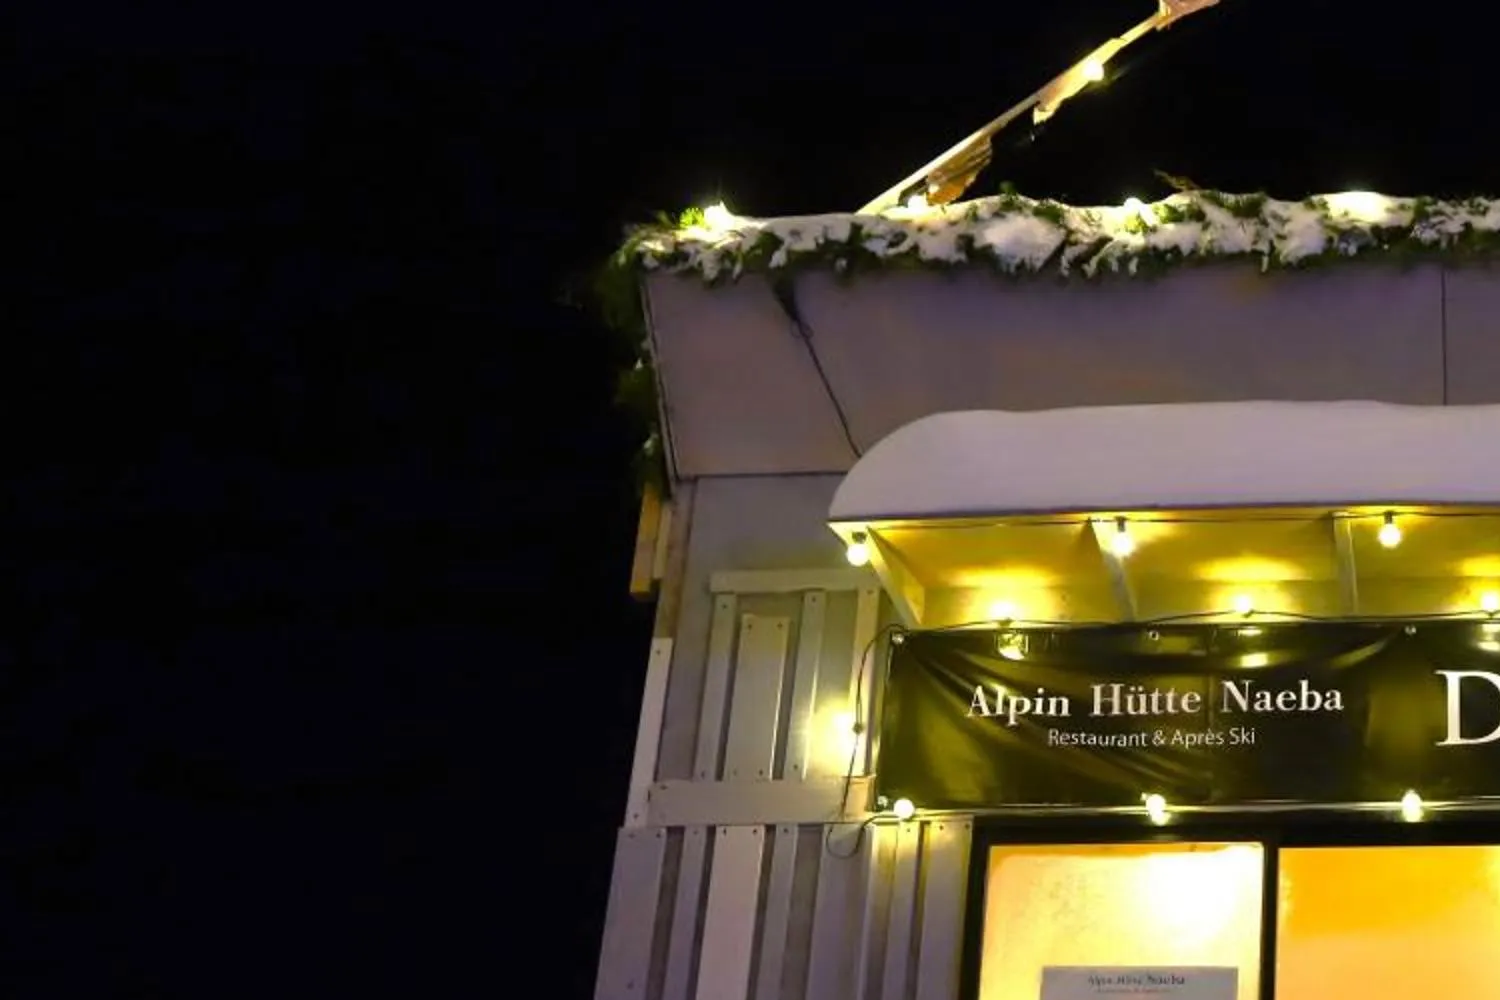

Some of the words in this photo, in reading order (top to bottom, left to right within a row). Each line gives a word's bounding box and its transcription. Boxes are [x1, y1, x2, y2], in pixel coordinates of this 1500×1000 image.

[967, 685, 1071, 726] Alpin
[1089, 682, 1202, 717] Hütte
[1222, 679, 1345, 714] Naeba
[1047, 727, 1148, 748] Restaurant
[1152, 730, 1167, 746] &
[1171, 728, 1225, 751] Après
[1229, 727, 1256, 746] Ski
